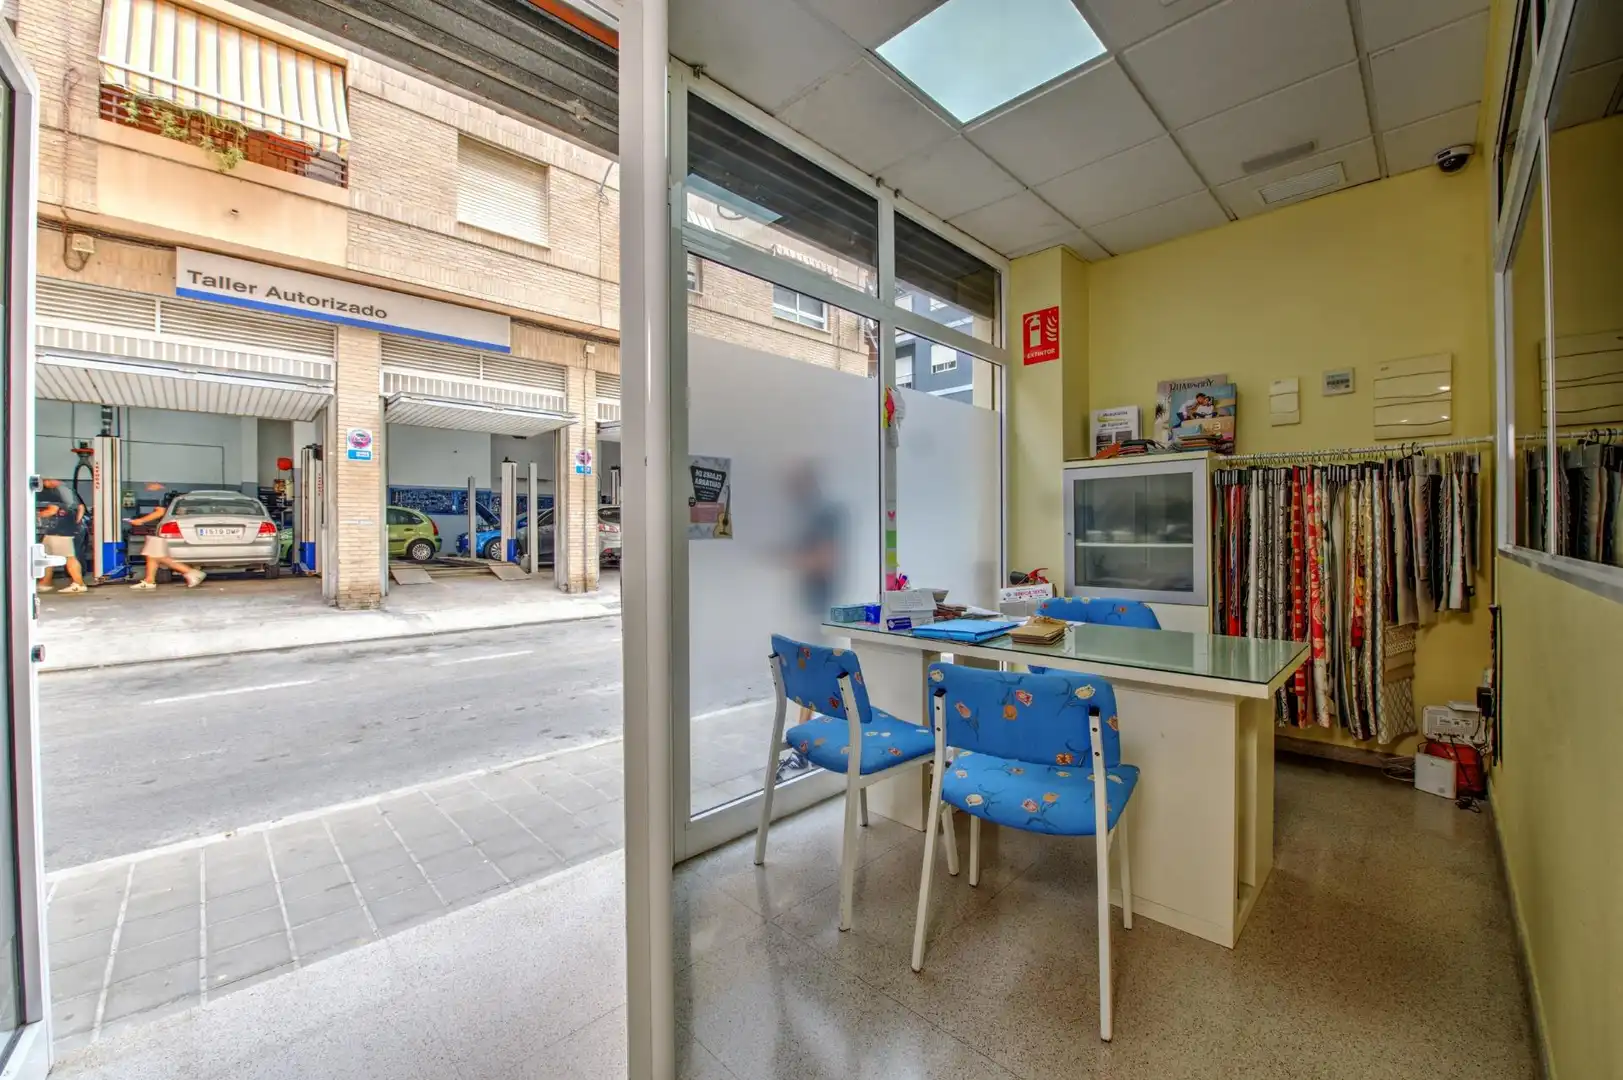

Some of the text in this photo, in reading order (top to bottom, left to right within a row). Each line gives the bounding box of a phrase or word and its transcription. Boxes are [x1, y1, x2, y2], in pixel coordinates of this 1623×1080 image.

[187, 269, 388, 319] Taller Autorizado
[1026, 348, 1056, 358] EXTINTOR
